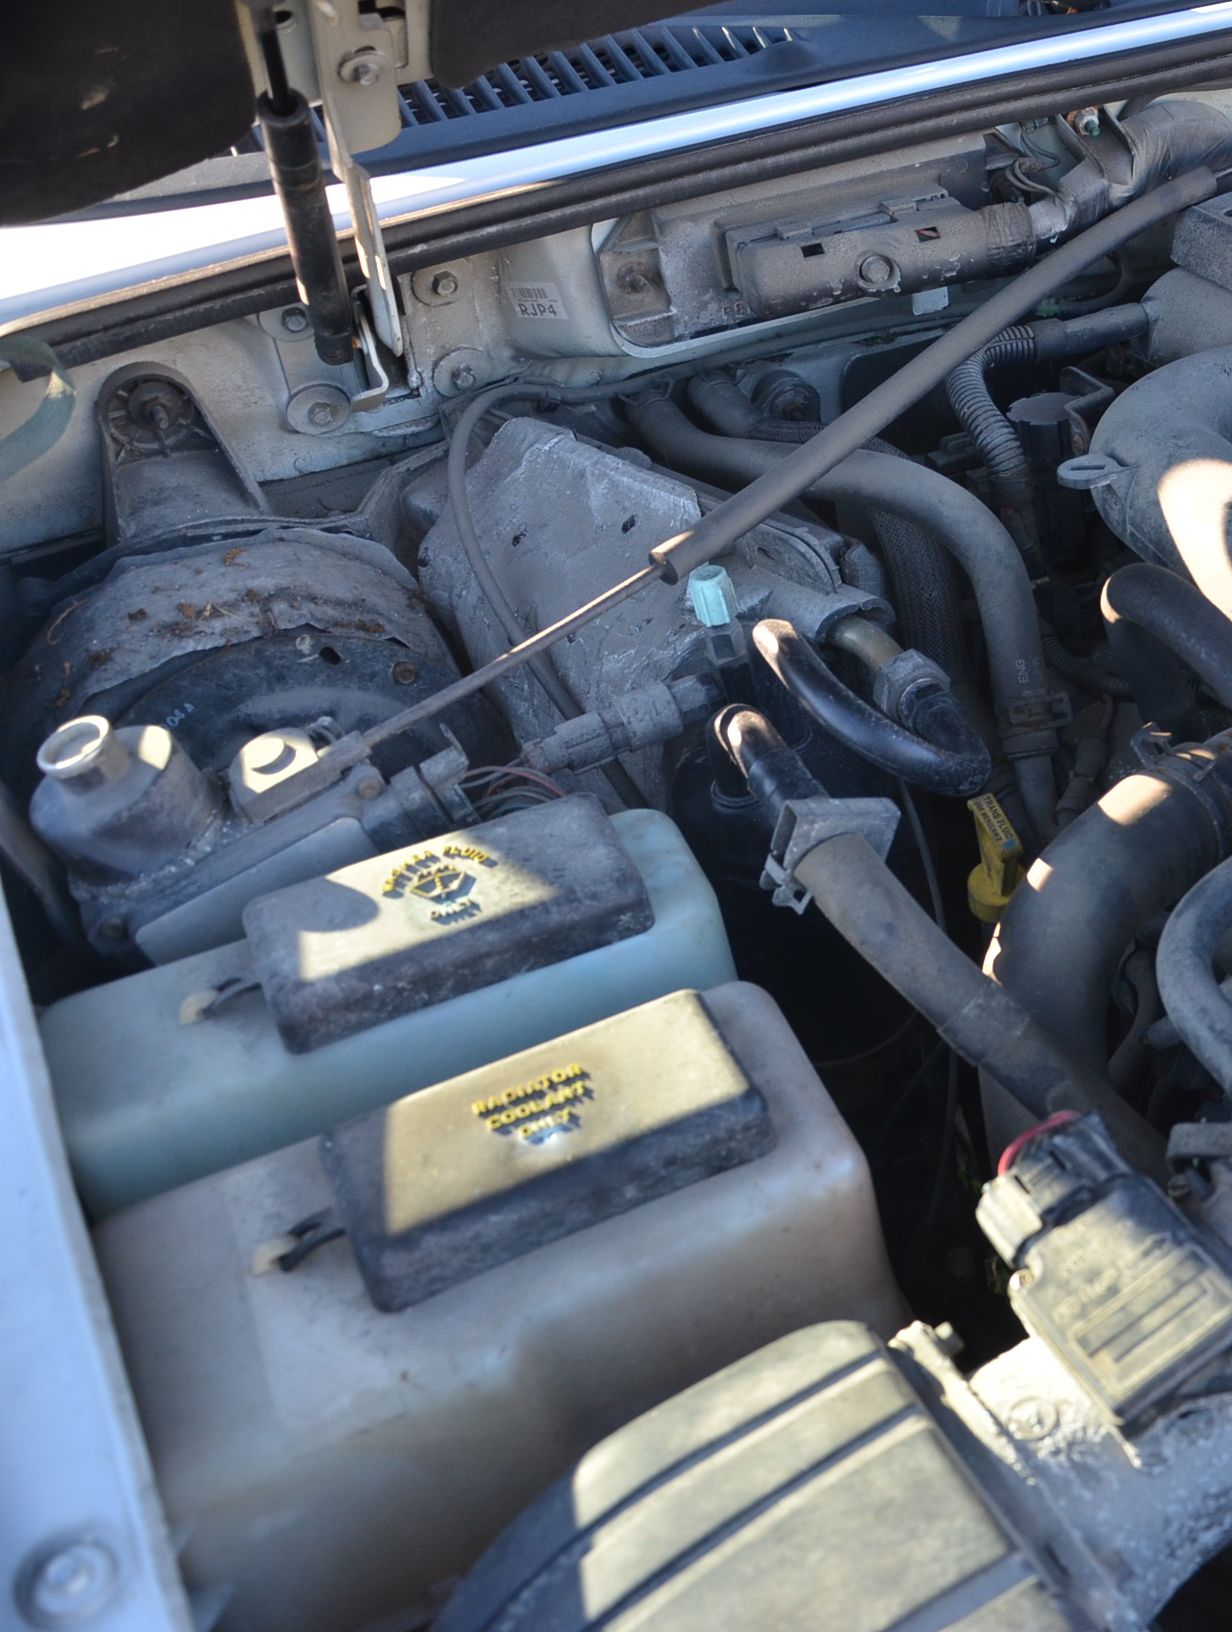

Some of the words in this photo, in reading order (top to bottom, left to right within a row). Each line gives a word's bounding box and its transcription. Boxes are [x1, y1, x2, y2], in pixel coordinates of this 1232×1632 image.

[518, 303, 557, 317] RJP4
[472, 1063, 583, 1115] RADIATOR
[486, 1081, 585, 1130] COOLANT
[517, 1107, 572, 1139] ONLY
